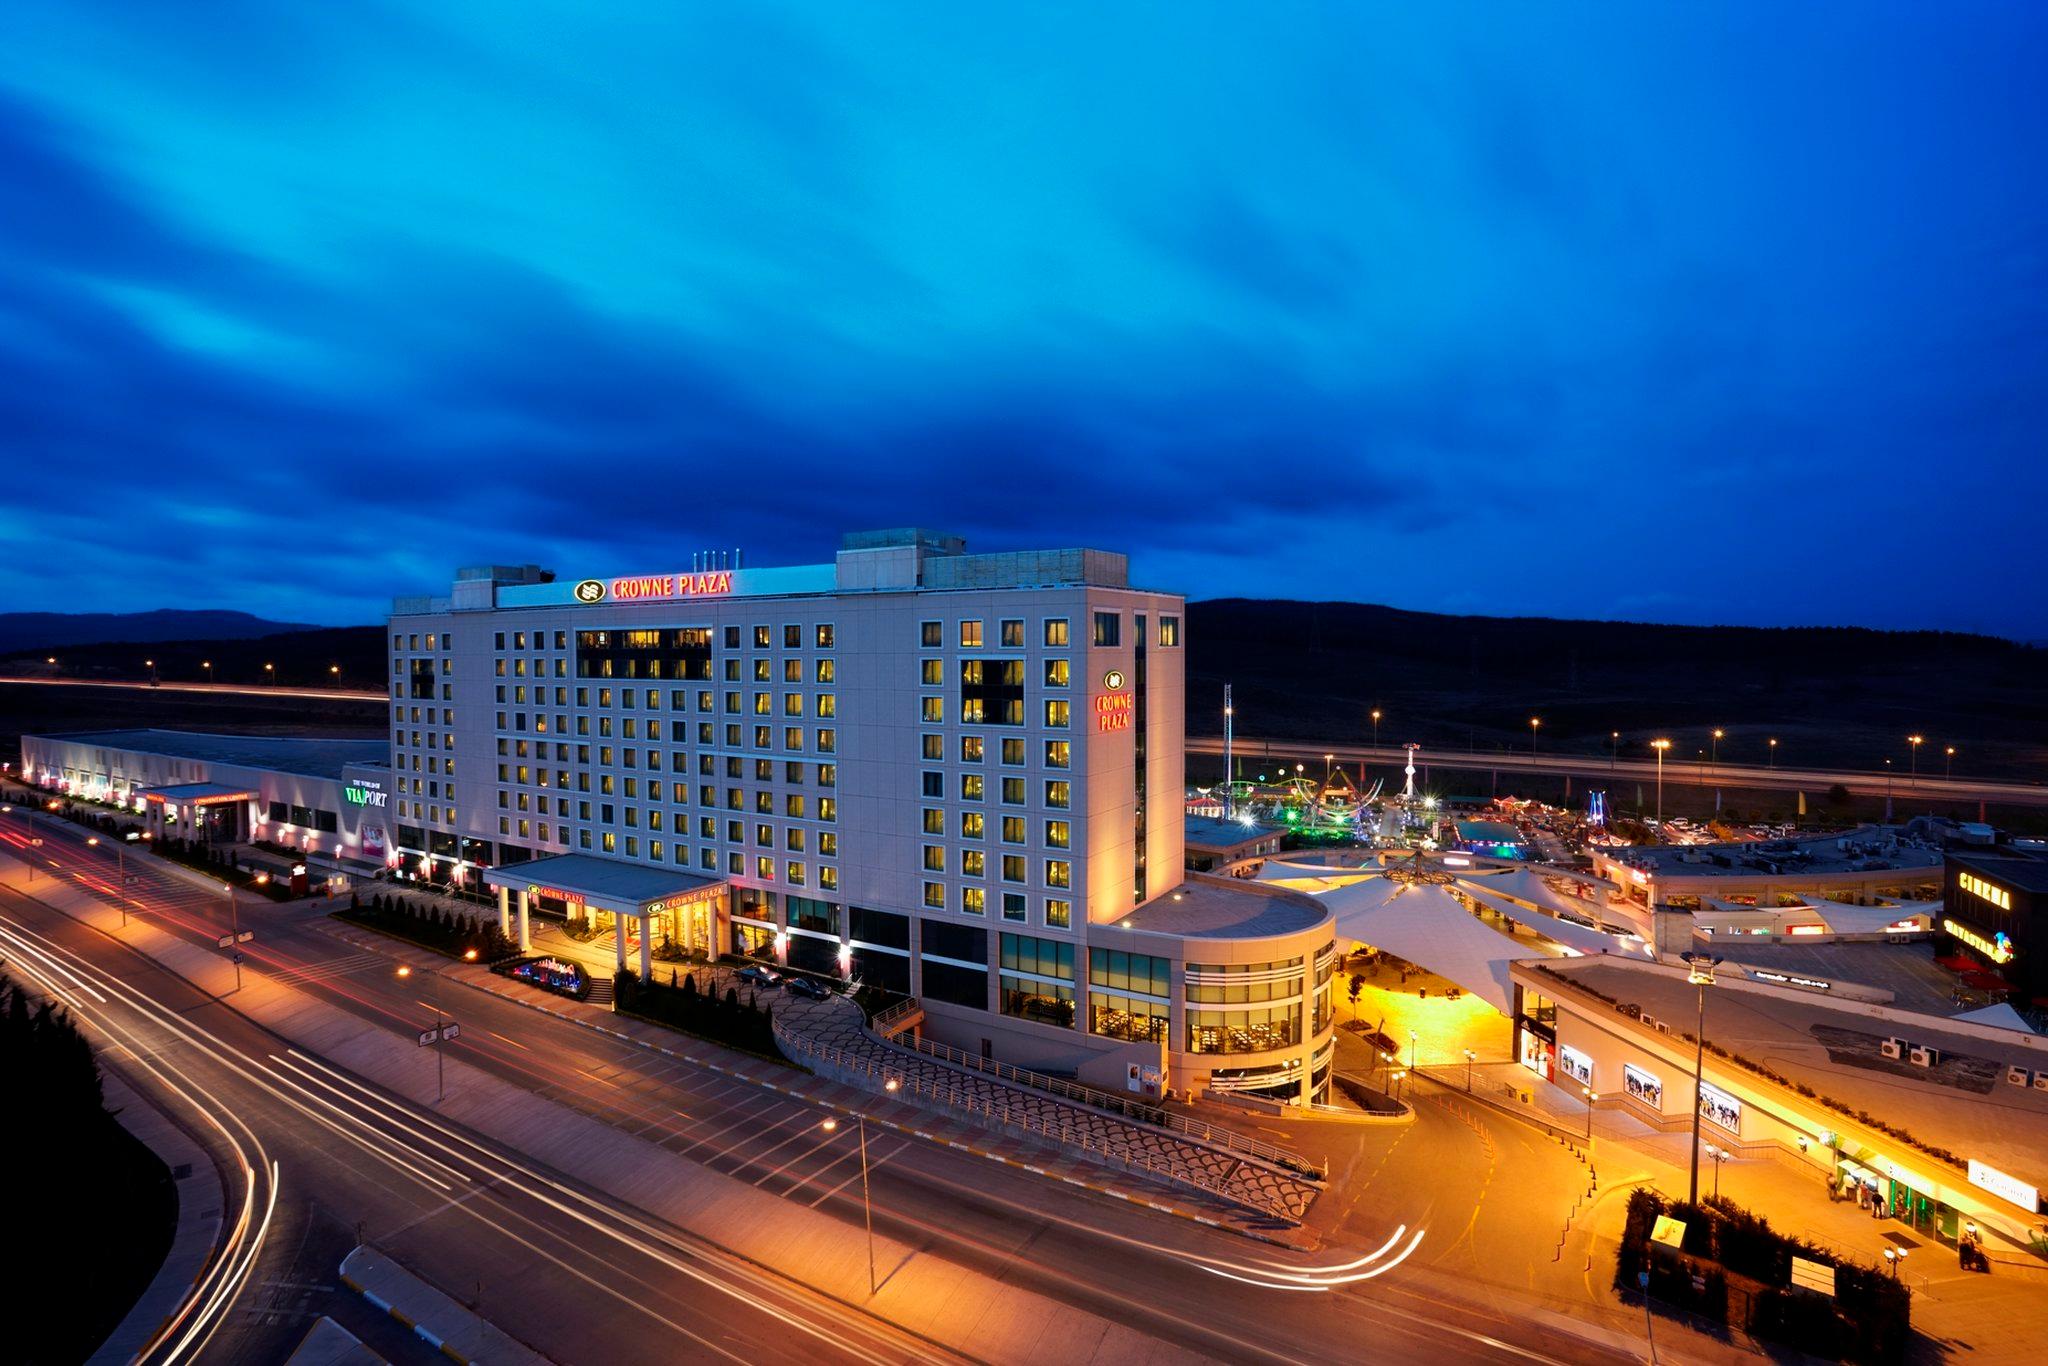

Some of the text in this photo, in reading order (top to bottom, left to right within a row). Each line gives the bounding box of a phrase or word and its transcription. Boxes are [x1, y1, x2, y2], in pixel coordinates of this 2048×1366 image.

[612, 572, 732, 599] CROWNE PLAZA
[1096, 694, 1132, 713] CROWNE
[1101, 713, 1129, 730] PLAZA
[540, 887, 564, 901] CROWNE
[666, 887, 723, 909] CROWNE PLAZA
[1959, 872, 2010, 911] CINEMA
